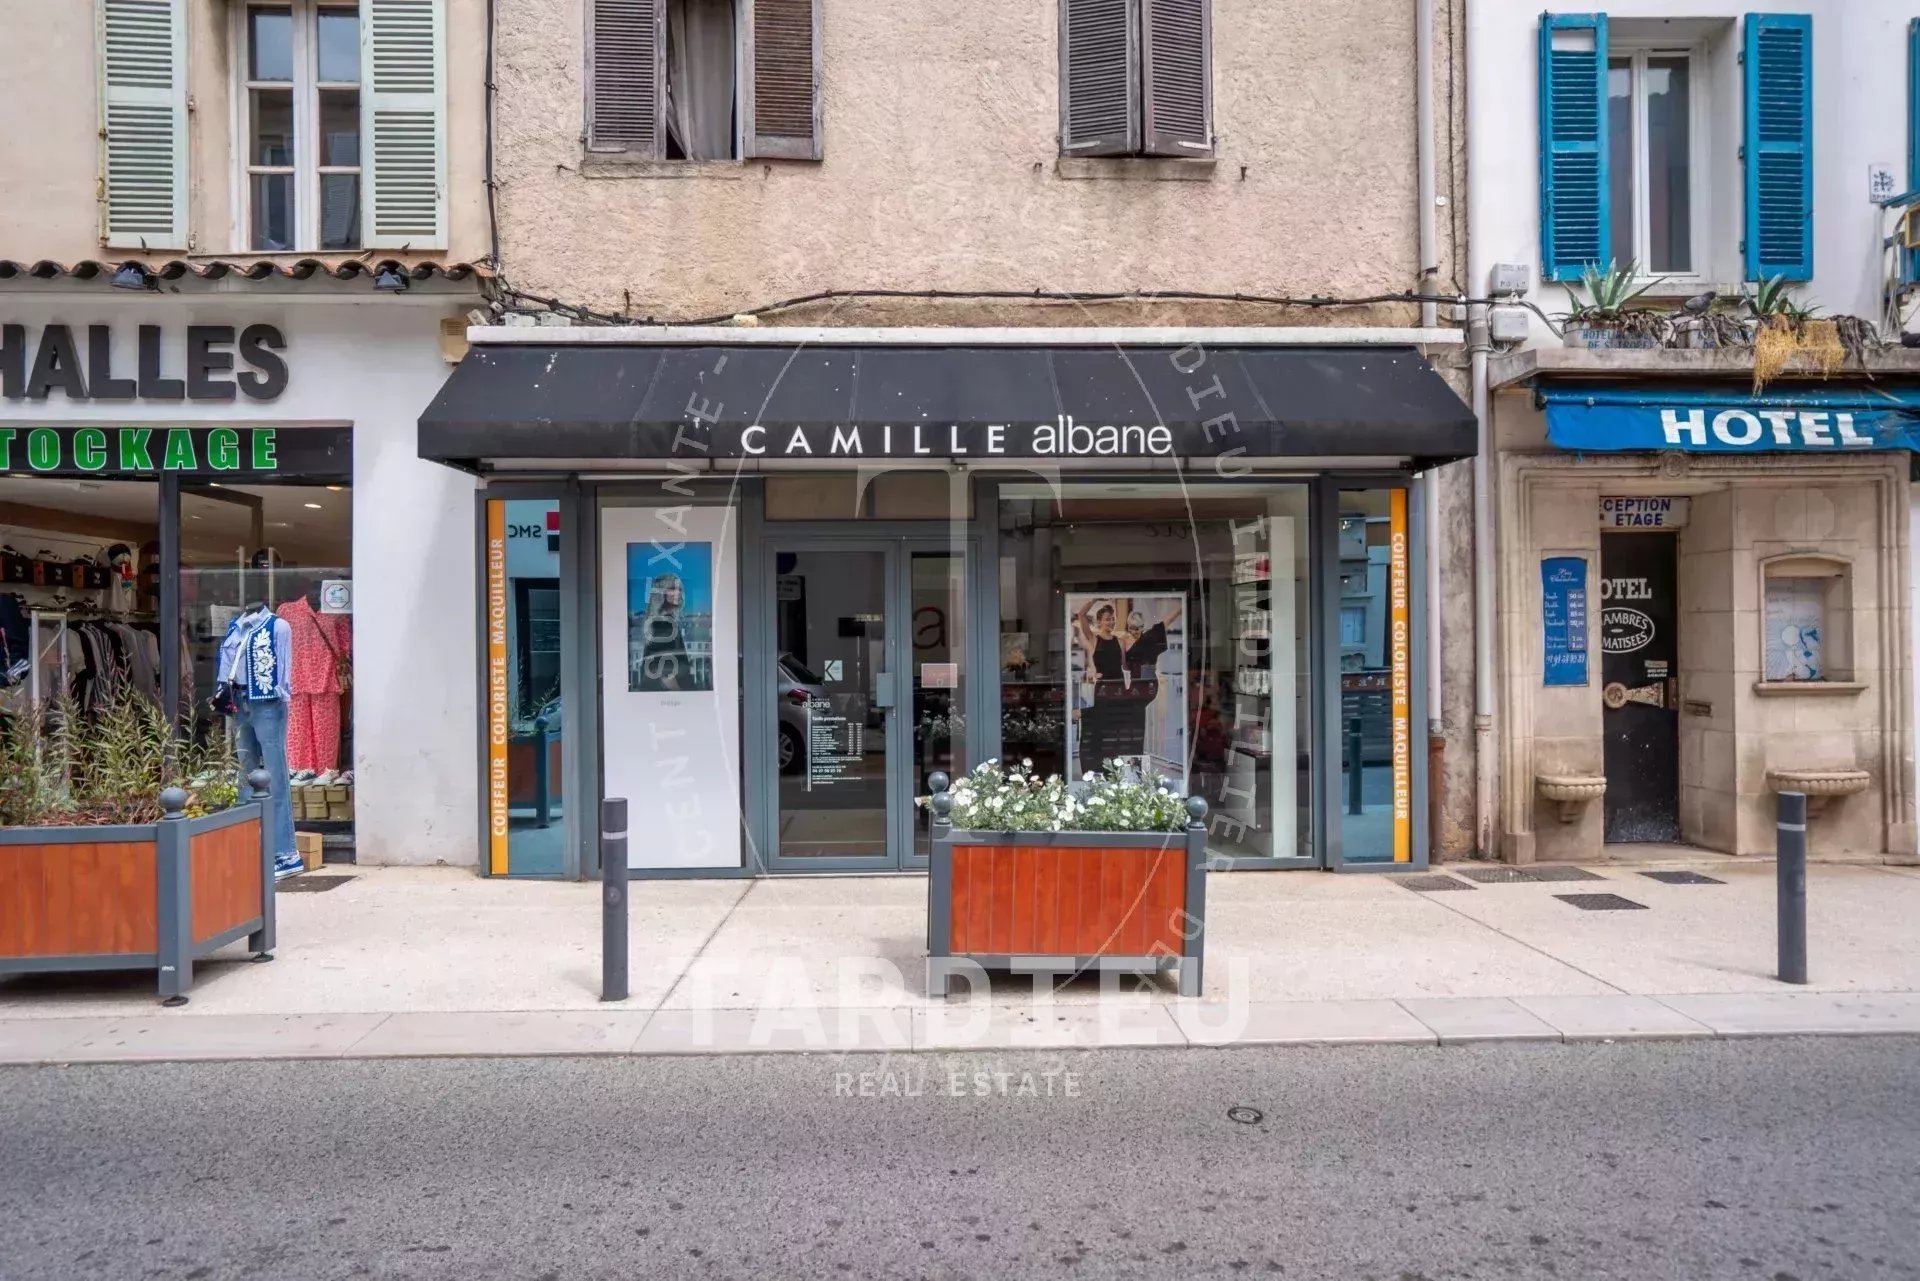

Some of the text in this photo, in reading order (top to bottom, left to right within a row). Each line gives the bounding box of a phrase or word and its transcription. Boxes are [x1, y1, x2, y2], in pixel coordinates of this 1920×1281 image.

[740, 413, 1173, 455] CAMILLE albane
[1660, 409, 1873, 446] HOTEL
[1615, 513, 1664, 526] ETAGE
[490, 537, 506, 837] COIFFEUR COLORISTE MAQUILLEUR
[1391, 532, 1409, 820] COIFFEUR COLORISTE MAQUILLEUR
